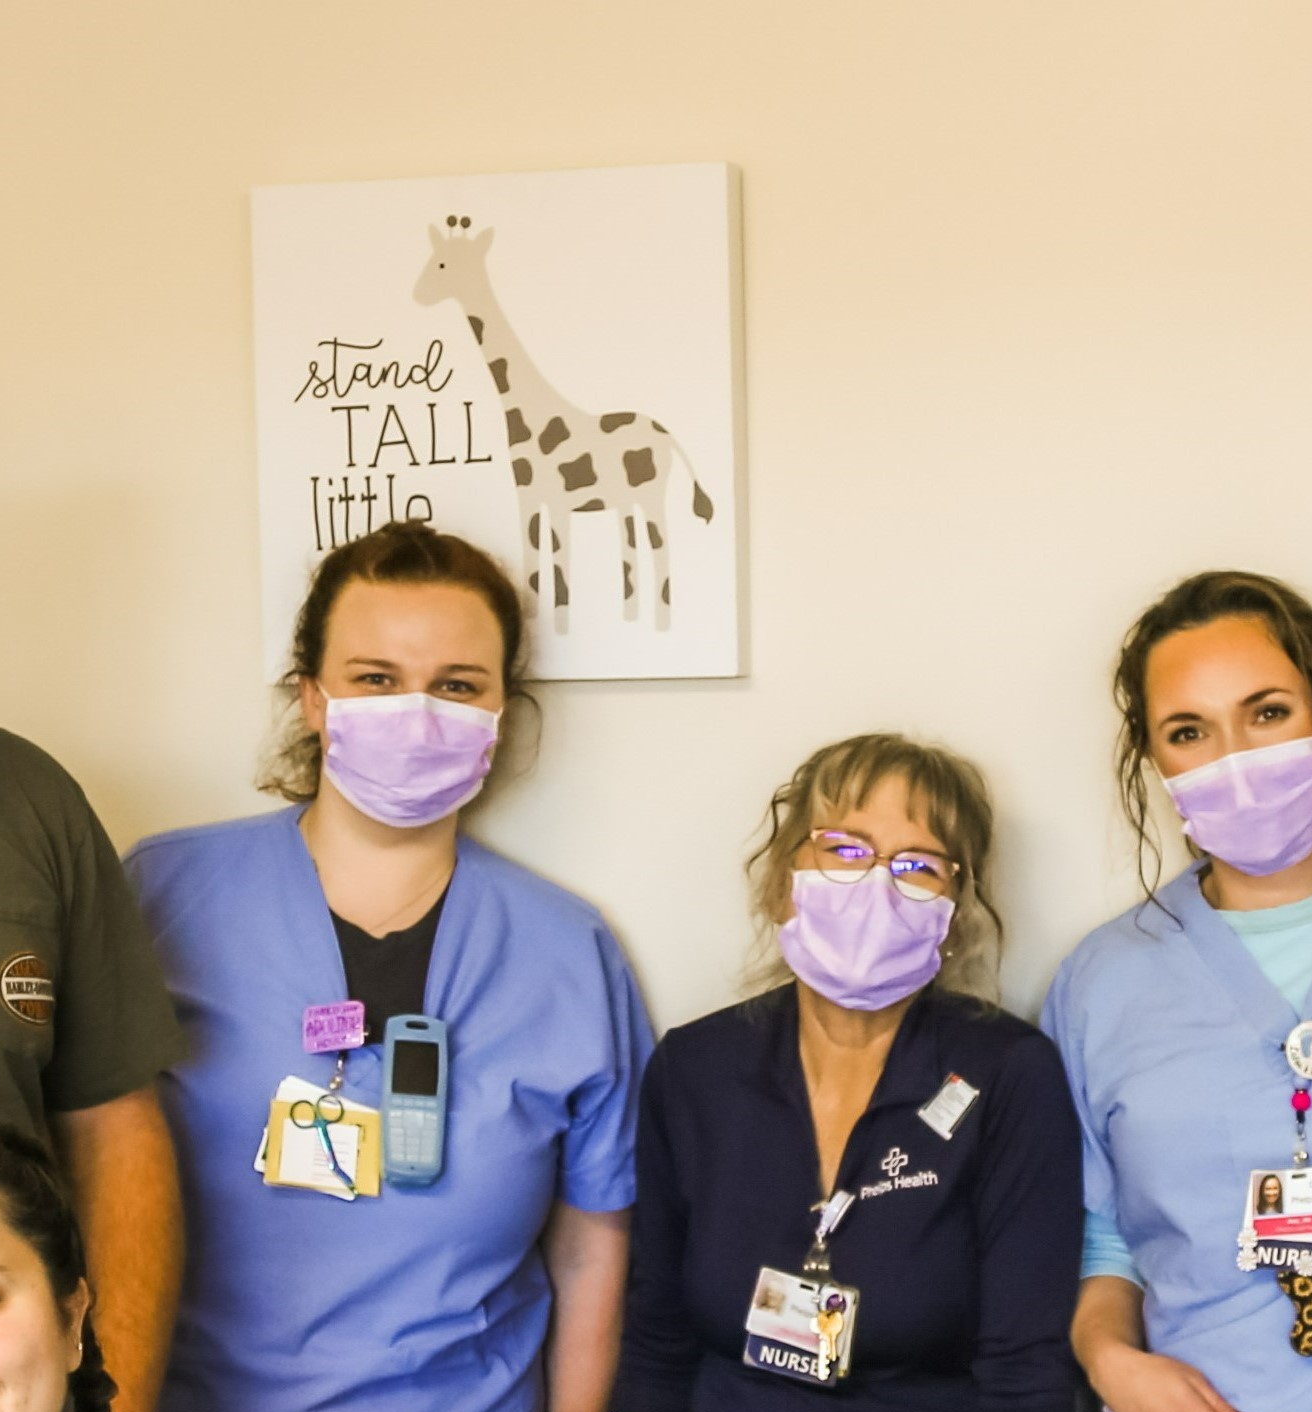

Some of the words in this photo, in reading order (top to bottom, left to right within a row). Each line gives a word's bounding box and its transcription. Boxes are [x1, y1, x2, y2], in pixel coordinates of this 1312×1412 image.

[294, 336, 454, 402] stand
[331, 401, 493, 468] TALL
[310, 473, 435, 552] little
[894, 1170, 939, 1190] Health
[759, 1345, 819, 1378] NURSE
